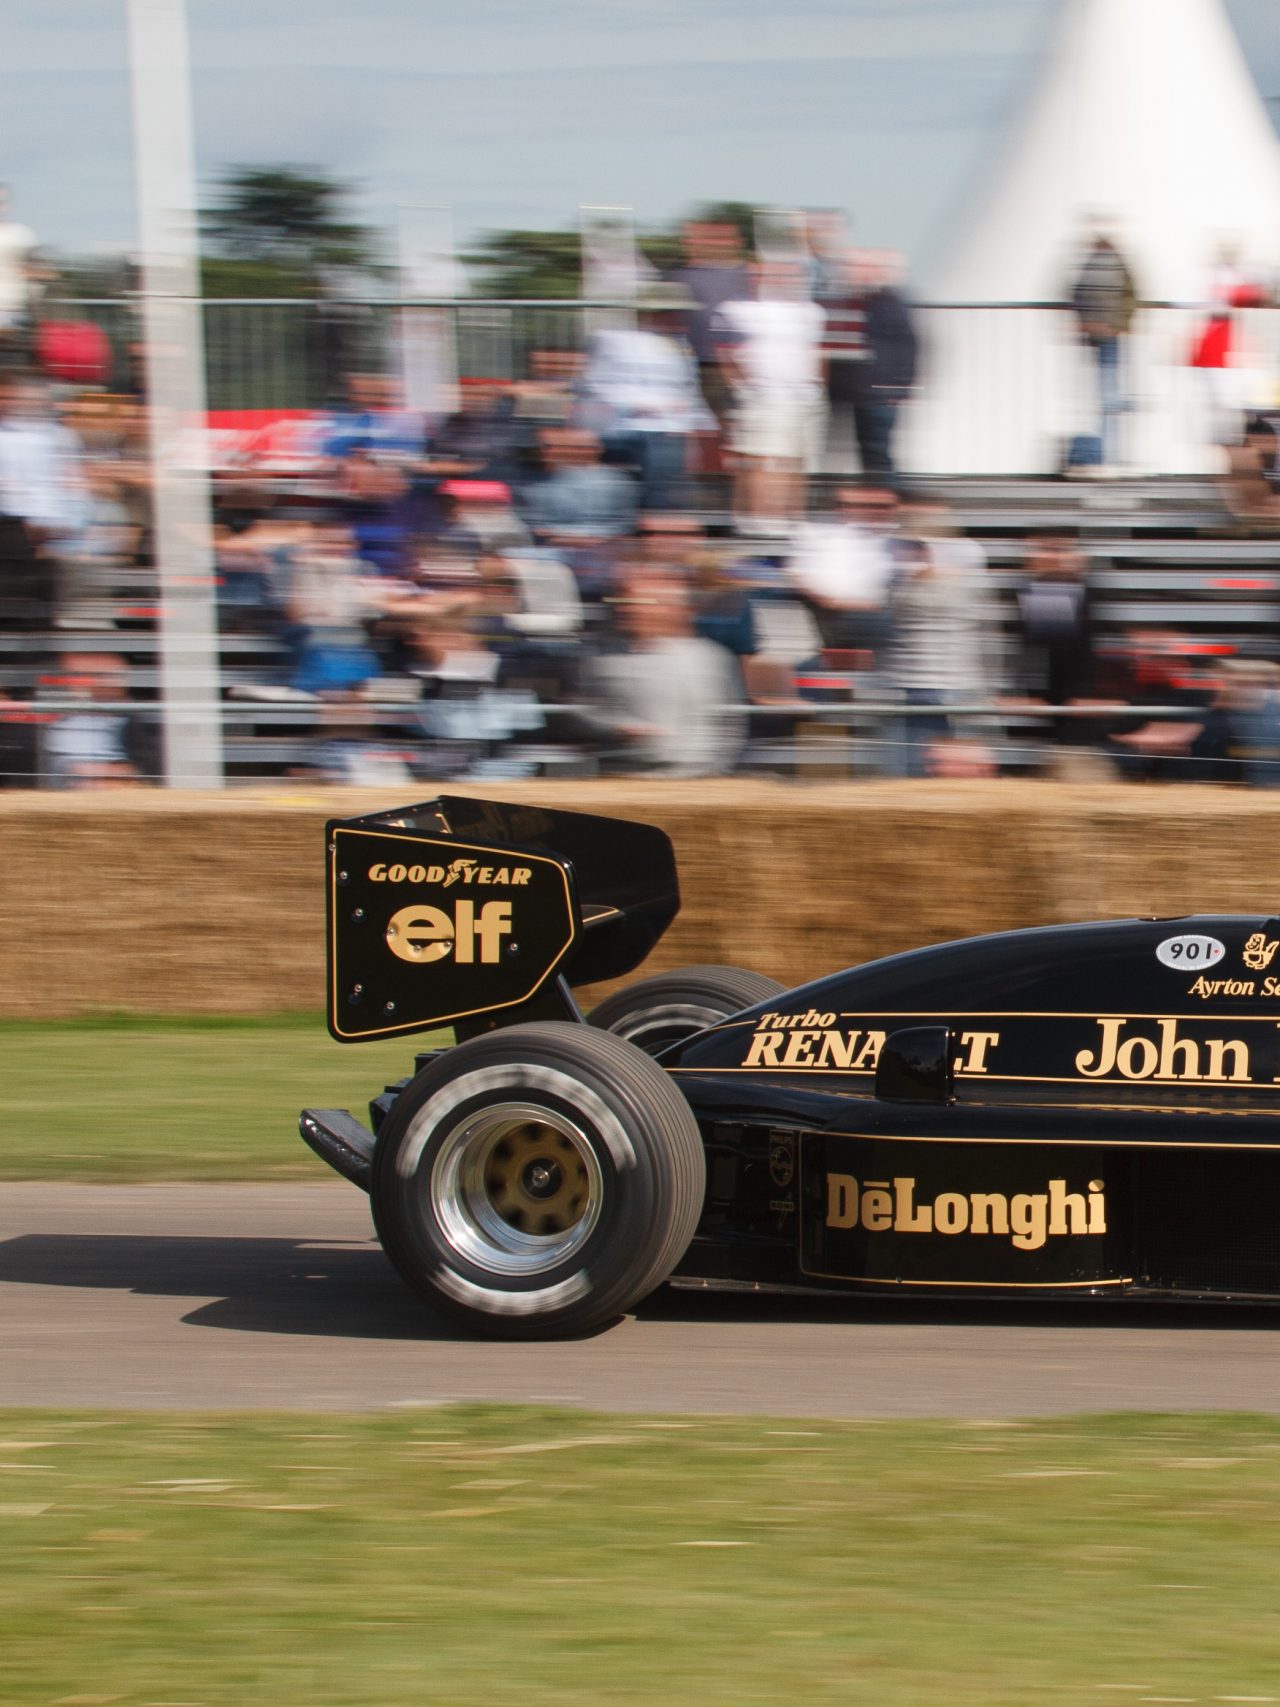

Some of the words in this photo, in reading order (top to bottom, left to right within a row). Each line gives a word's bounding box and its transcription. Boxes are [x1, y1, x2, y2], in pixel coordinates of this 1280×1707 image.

[368, 859, 532, 888] GOODYEAR
[386, 899, 512, 964] elf
[1170, 942, 1213, 960] 901
[1188, 975, 1255, 999] Ayrton
[755, 1009, 837, 1031] Turbo
[741, 1030, 1000, 1073] RENAT
[1075, 1018, 1252, 1080] John
